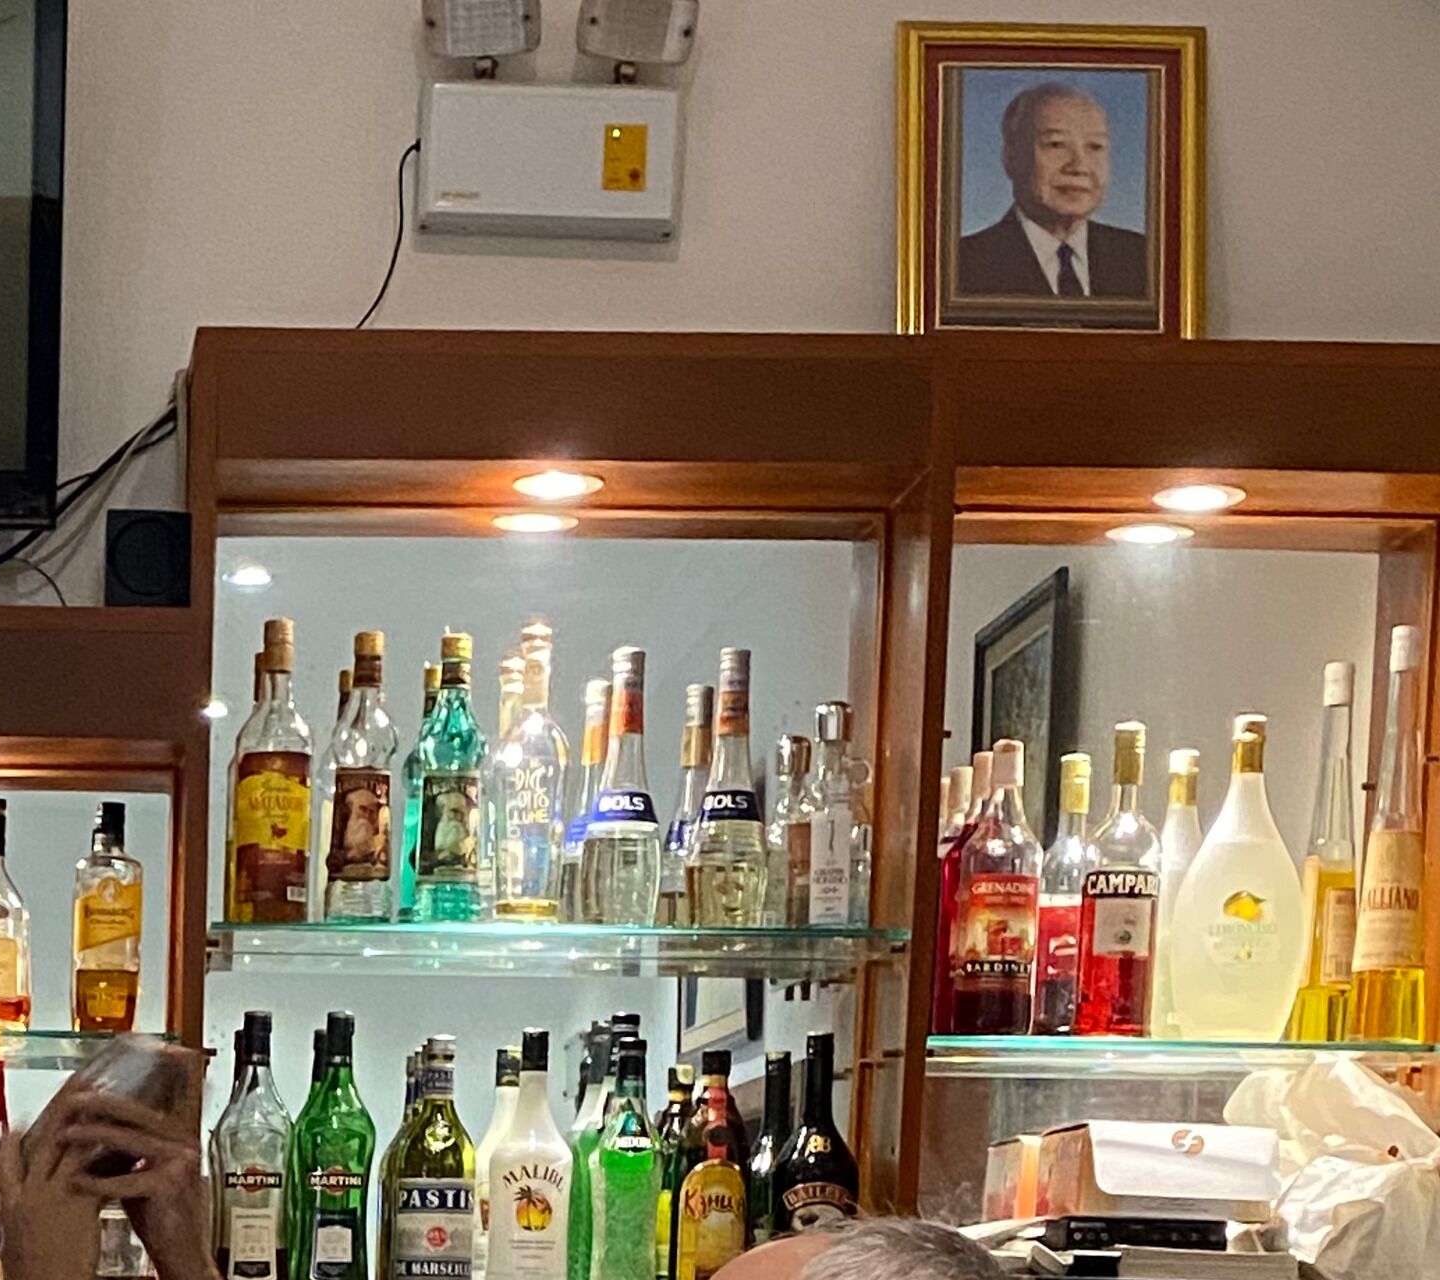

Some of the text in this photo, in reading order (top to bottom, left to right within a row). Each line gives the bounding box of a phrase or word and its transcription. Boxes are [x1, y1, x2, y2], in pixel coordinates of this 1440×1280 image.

[598, 796, 644, 811] BOLS
[704, 795, 747, 810] BOLS
[1087, 874, 1159, 896] CAMPARI
[227, 1174, 280, 1186] MARTINI
[310, 1174, 361, 1186] MARTINI
[411, 1261, 470, 1275] MARSEILL
